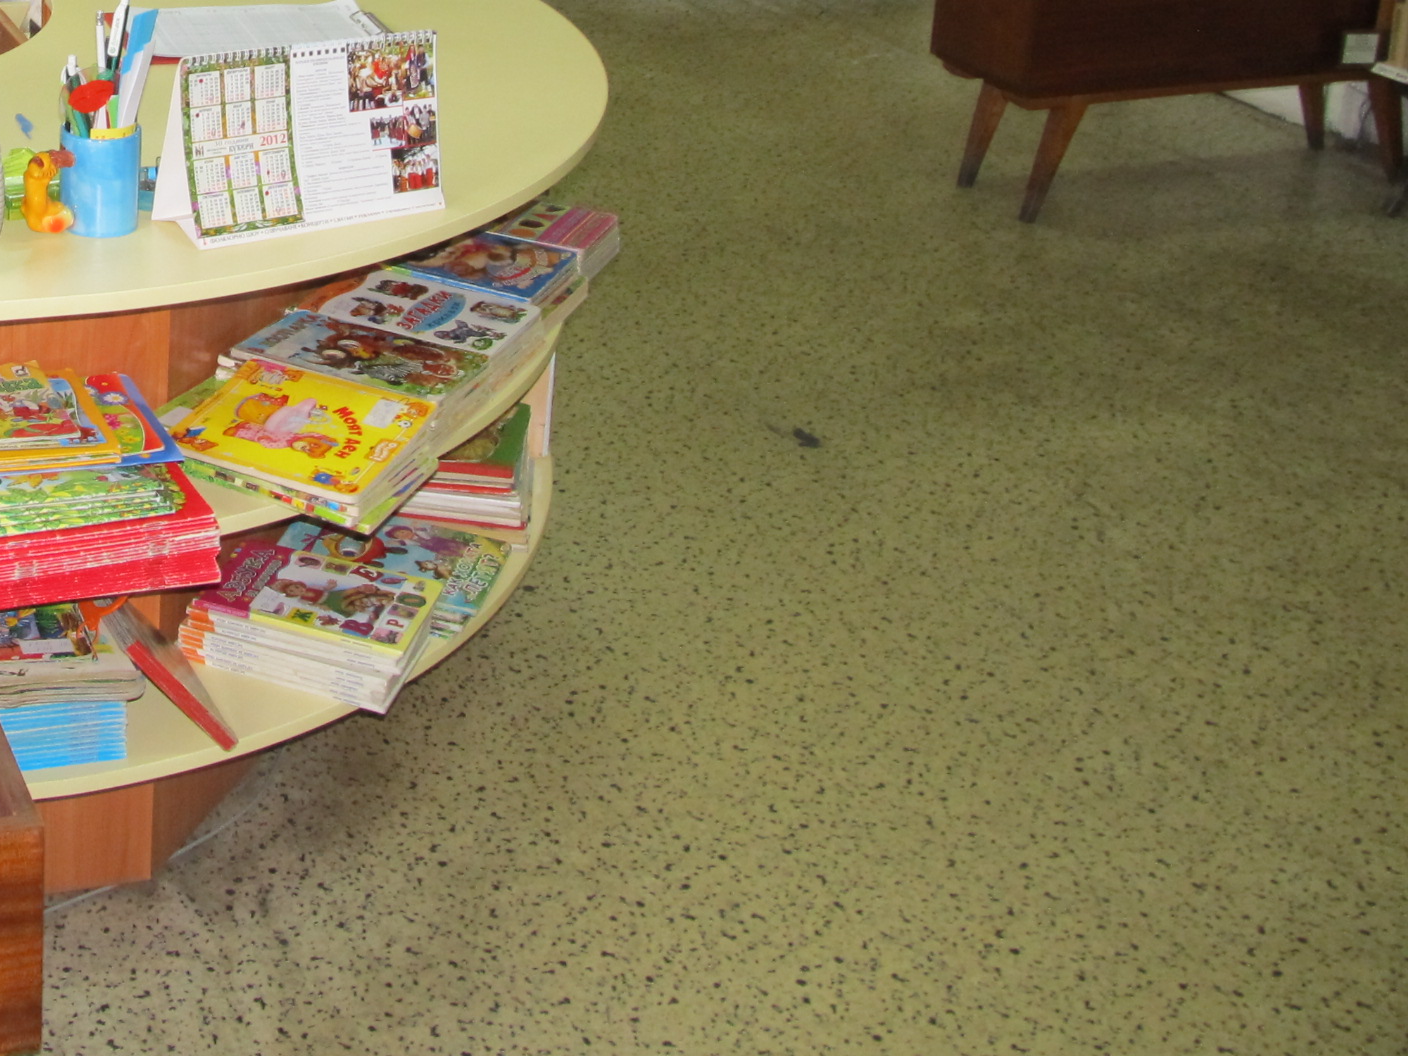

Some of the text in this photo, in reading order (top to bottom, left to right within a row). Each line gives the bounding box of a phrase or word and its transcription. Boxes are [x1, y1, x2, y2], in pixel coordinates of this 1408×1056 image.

[259, 133, 287, 147] 2012
[395, 290, 453, 331] ЗАГАДКИ
[332, 406, 363, 436] Моят
[216, 548, 276, 603] АЗБУКА
